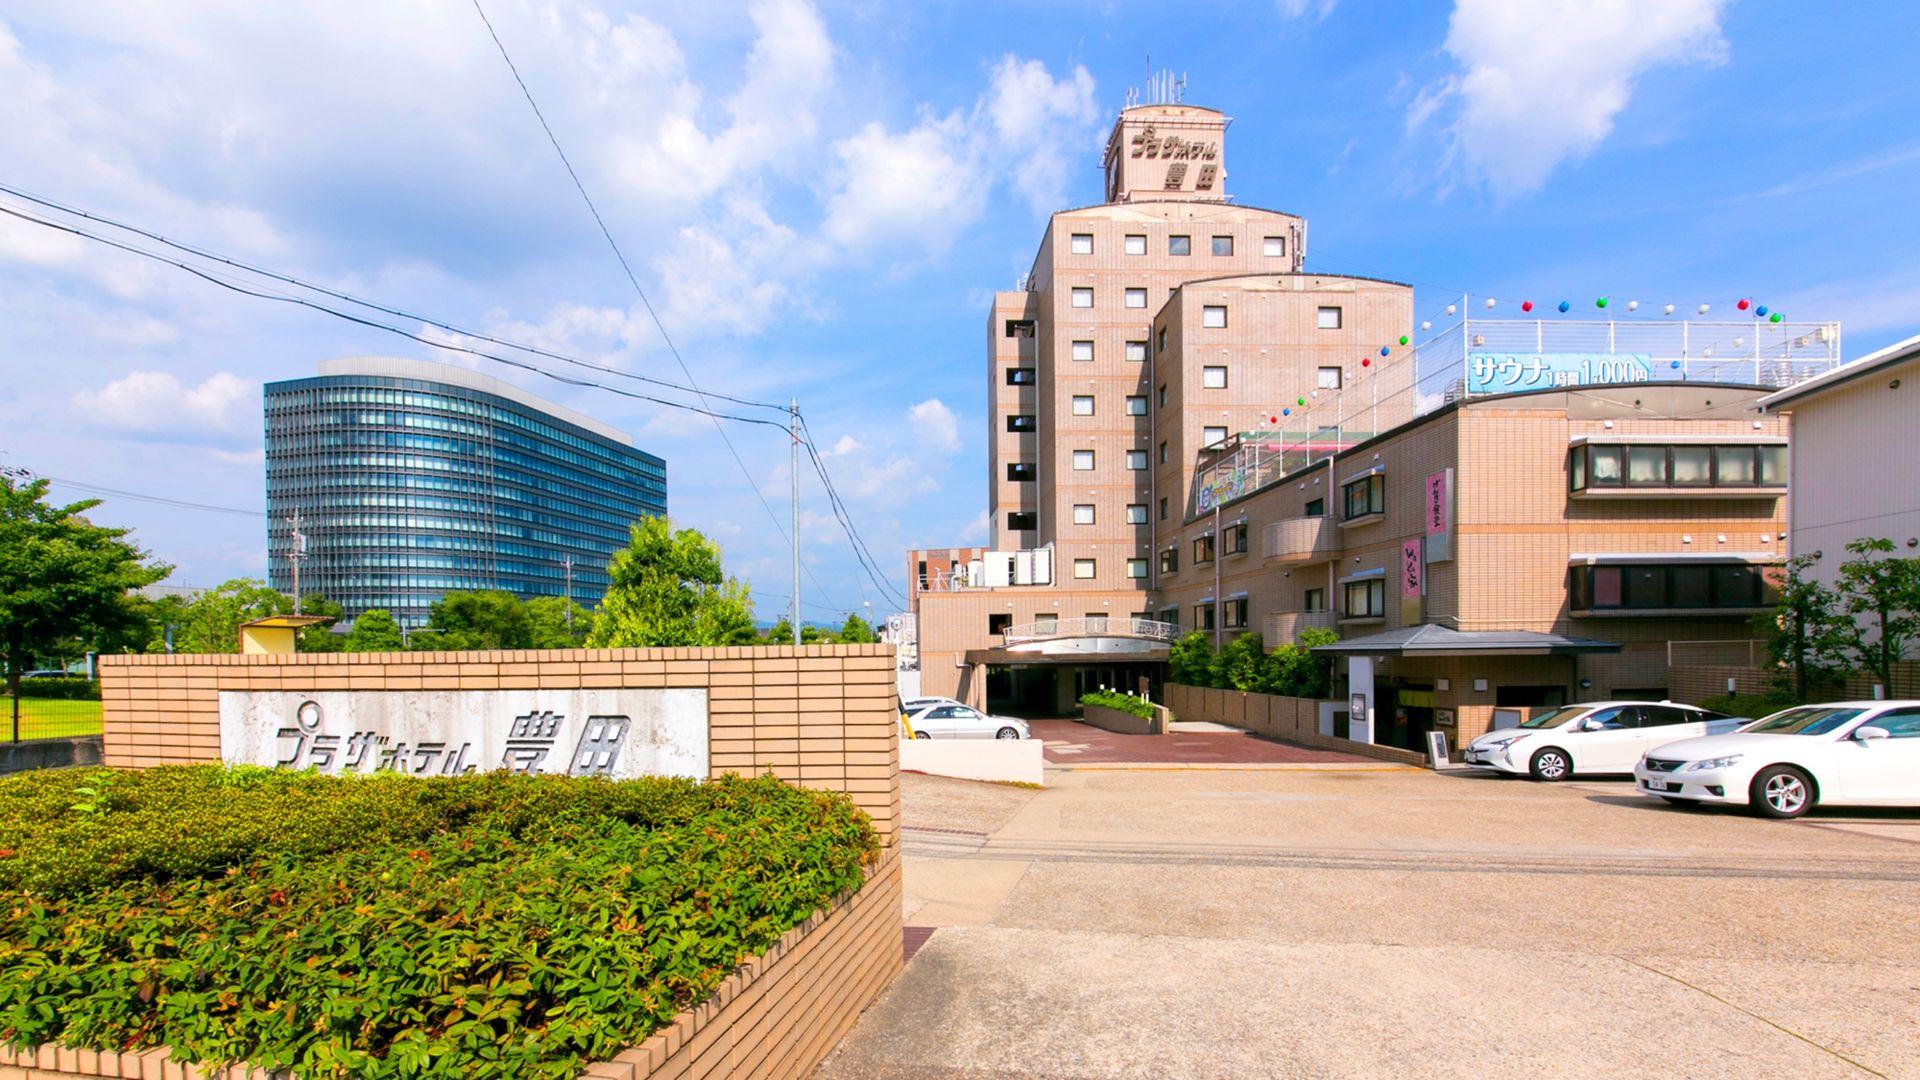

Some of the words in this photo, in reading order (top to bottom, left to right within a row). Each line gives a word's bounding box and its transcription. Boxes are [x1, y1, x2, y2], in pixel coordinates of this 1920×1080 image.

[1131, 125, 1218, 160] プラザホテル
[1164, 162, 1218, 190] 豊田
[276, 700, 477, 774] プラザホテル
[502, 710, 632, 774] 豊田
